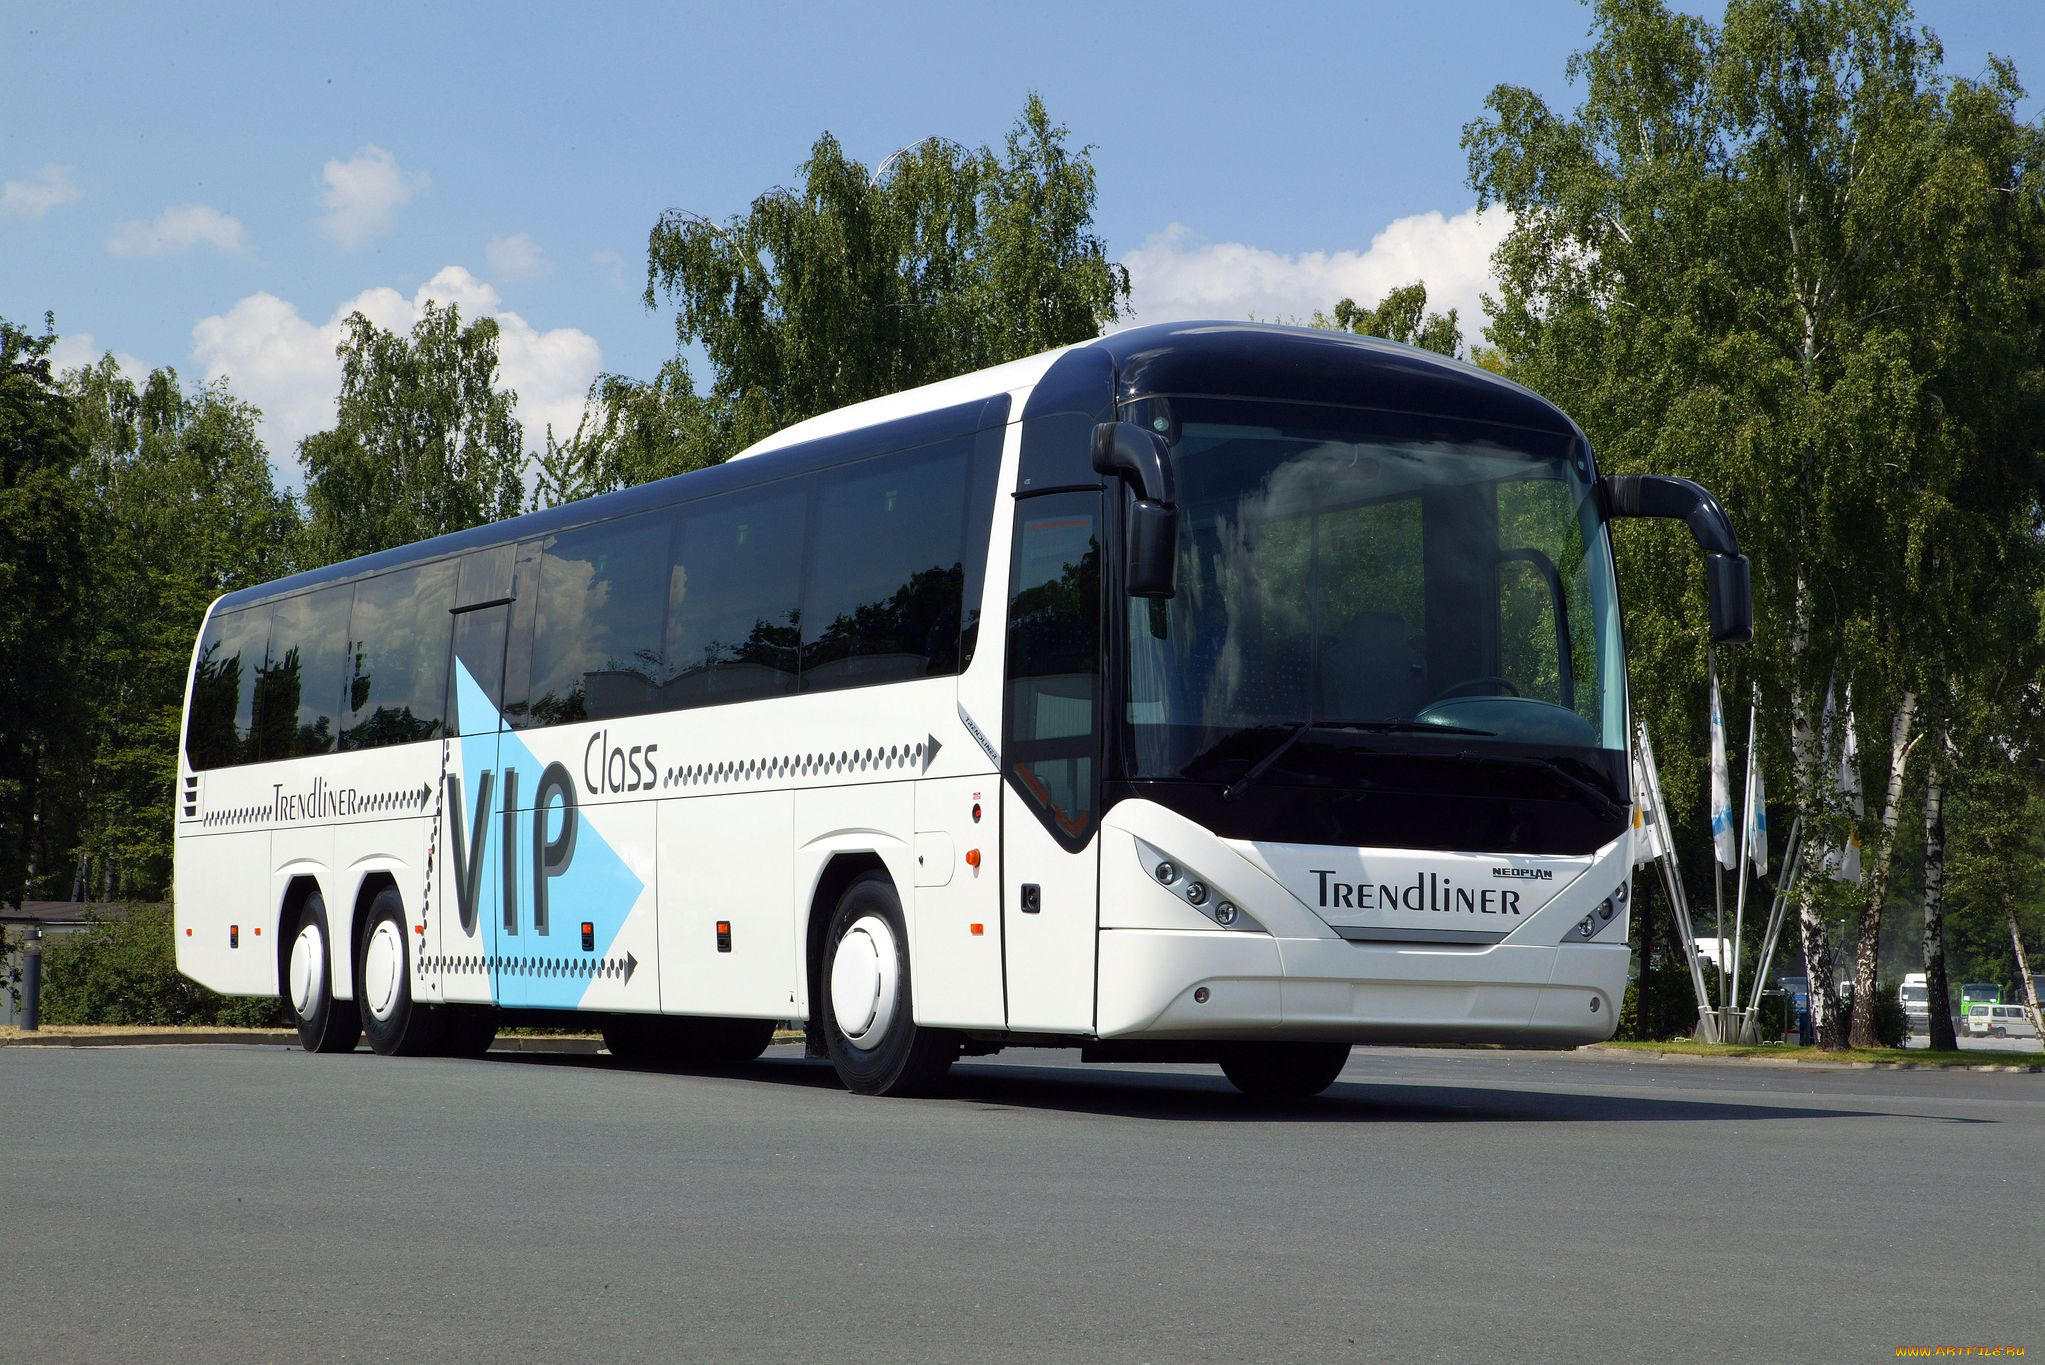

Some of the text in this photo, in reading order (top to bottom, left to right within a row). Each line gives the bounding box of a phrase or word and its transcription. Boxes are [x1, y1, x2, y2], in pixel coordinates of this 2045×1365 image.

[965, 717, 997, 760] TRENDLINER
[447, 729, 658, 938] VIP Class
[1492, 867, 1553, 880] NEOPLAN
